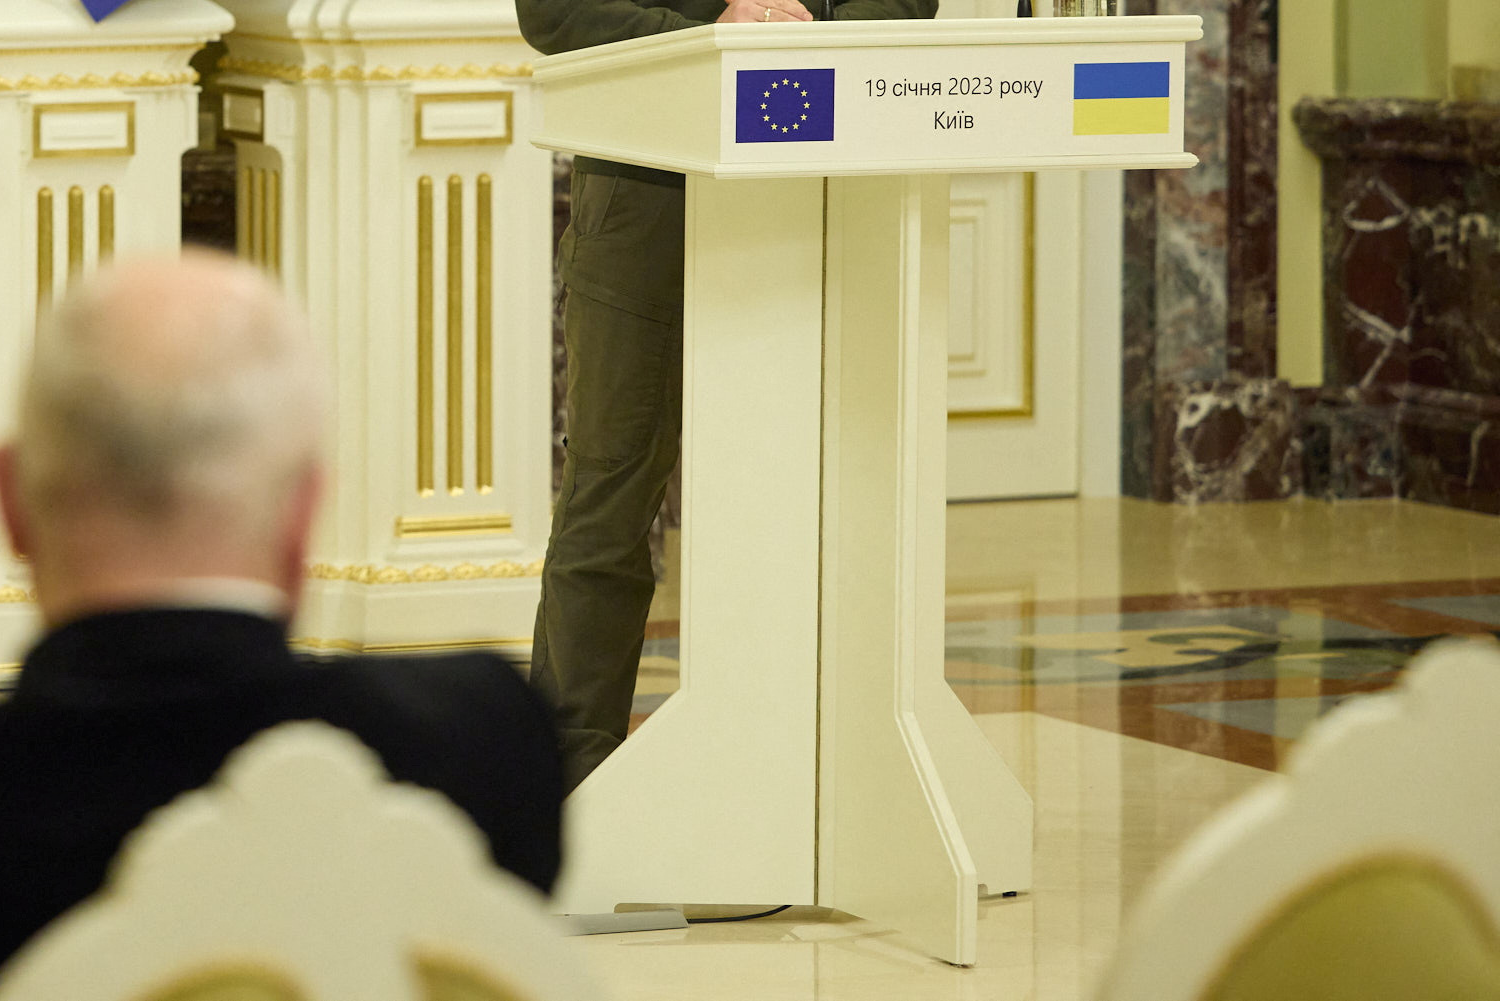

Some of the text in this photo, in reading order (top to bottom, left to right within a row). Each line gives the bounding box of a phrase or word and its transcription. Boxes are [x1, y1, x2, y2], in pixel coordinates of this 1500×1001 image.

[865, 76, 1044, 99] 19 січня 2023 року
[934, 110, 975, 130] Київ
